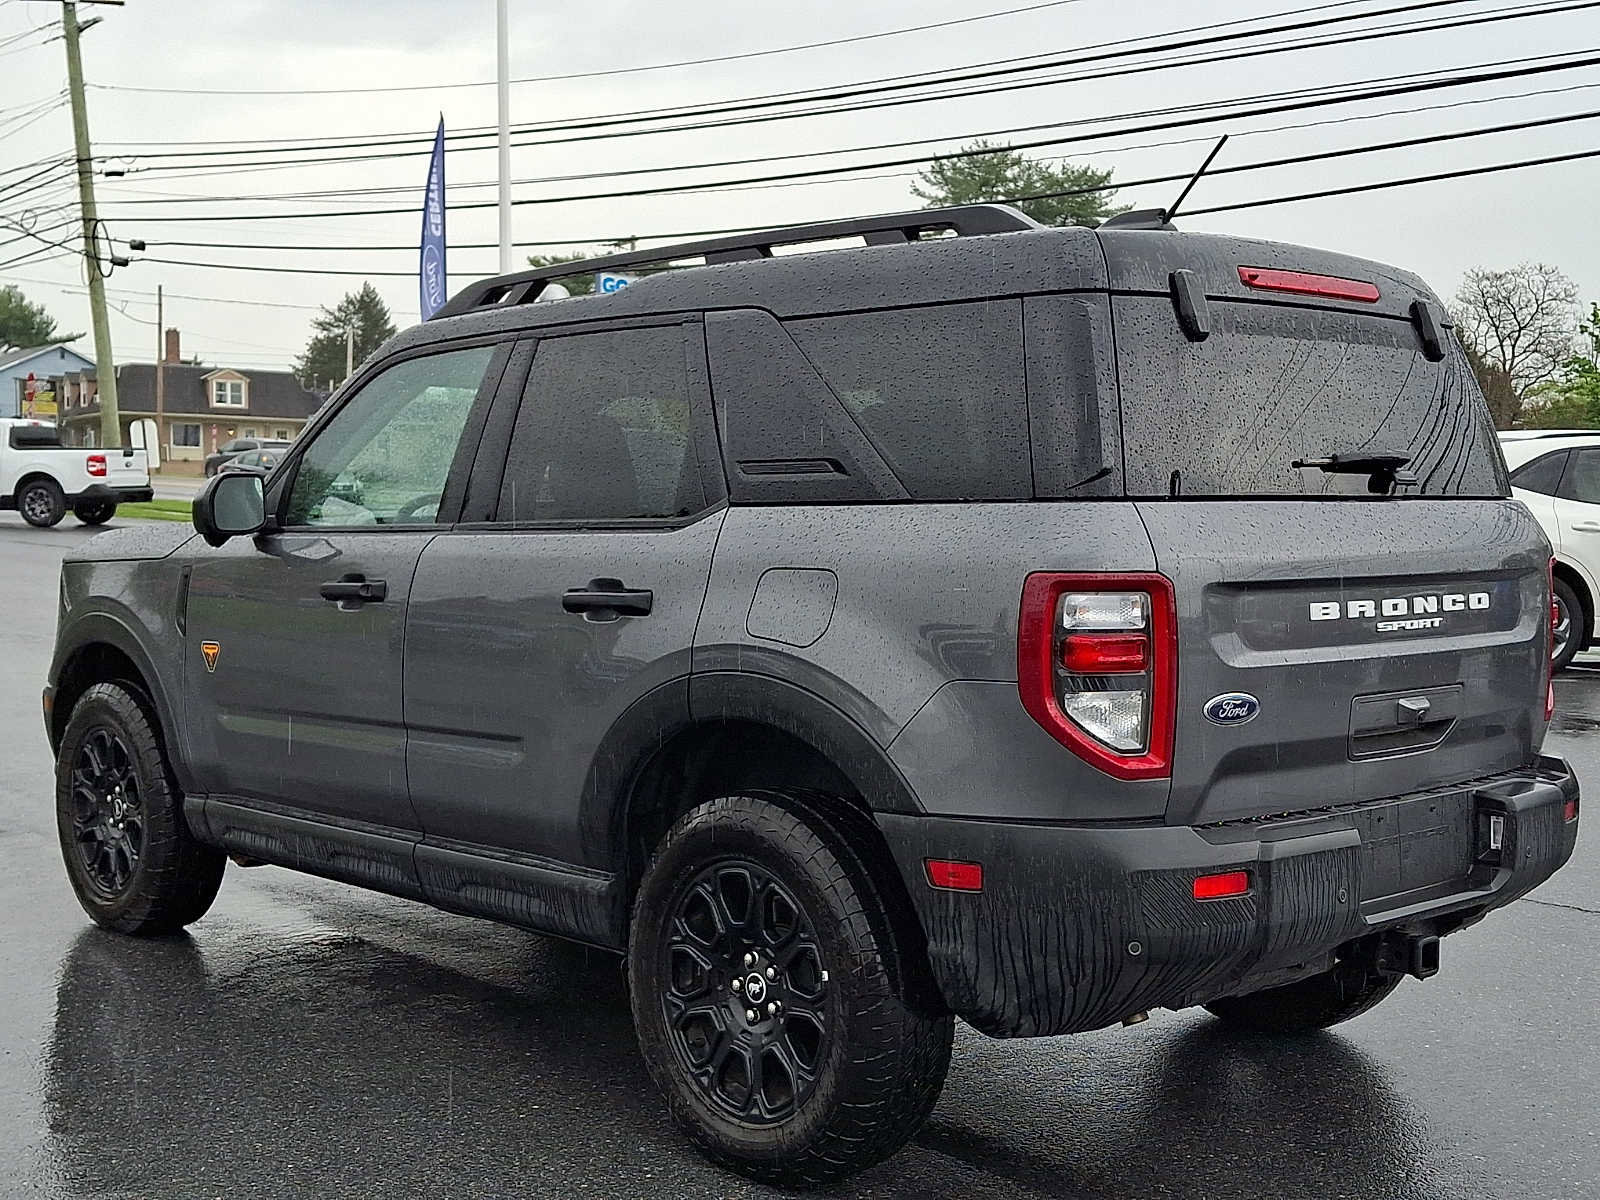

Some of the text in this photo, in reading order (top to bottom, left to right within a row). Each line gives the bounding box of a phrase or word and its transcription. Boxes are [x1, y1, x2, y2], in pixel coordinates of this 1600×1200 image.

[1309, 592, 1490, 621] BRONCO
[1377, 617, 1443, 632] SPORT
[1218, 700, 1249, 718] Ford
